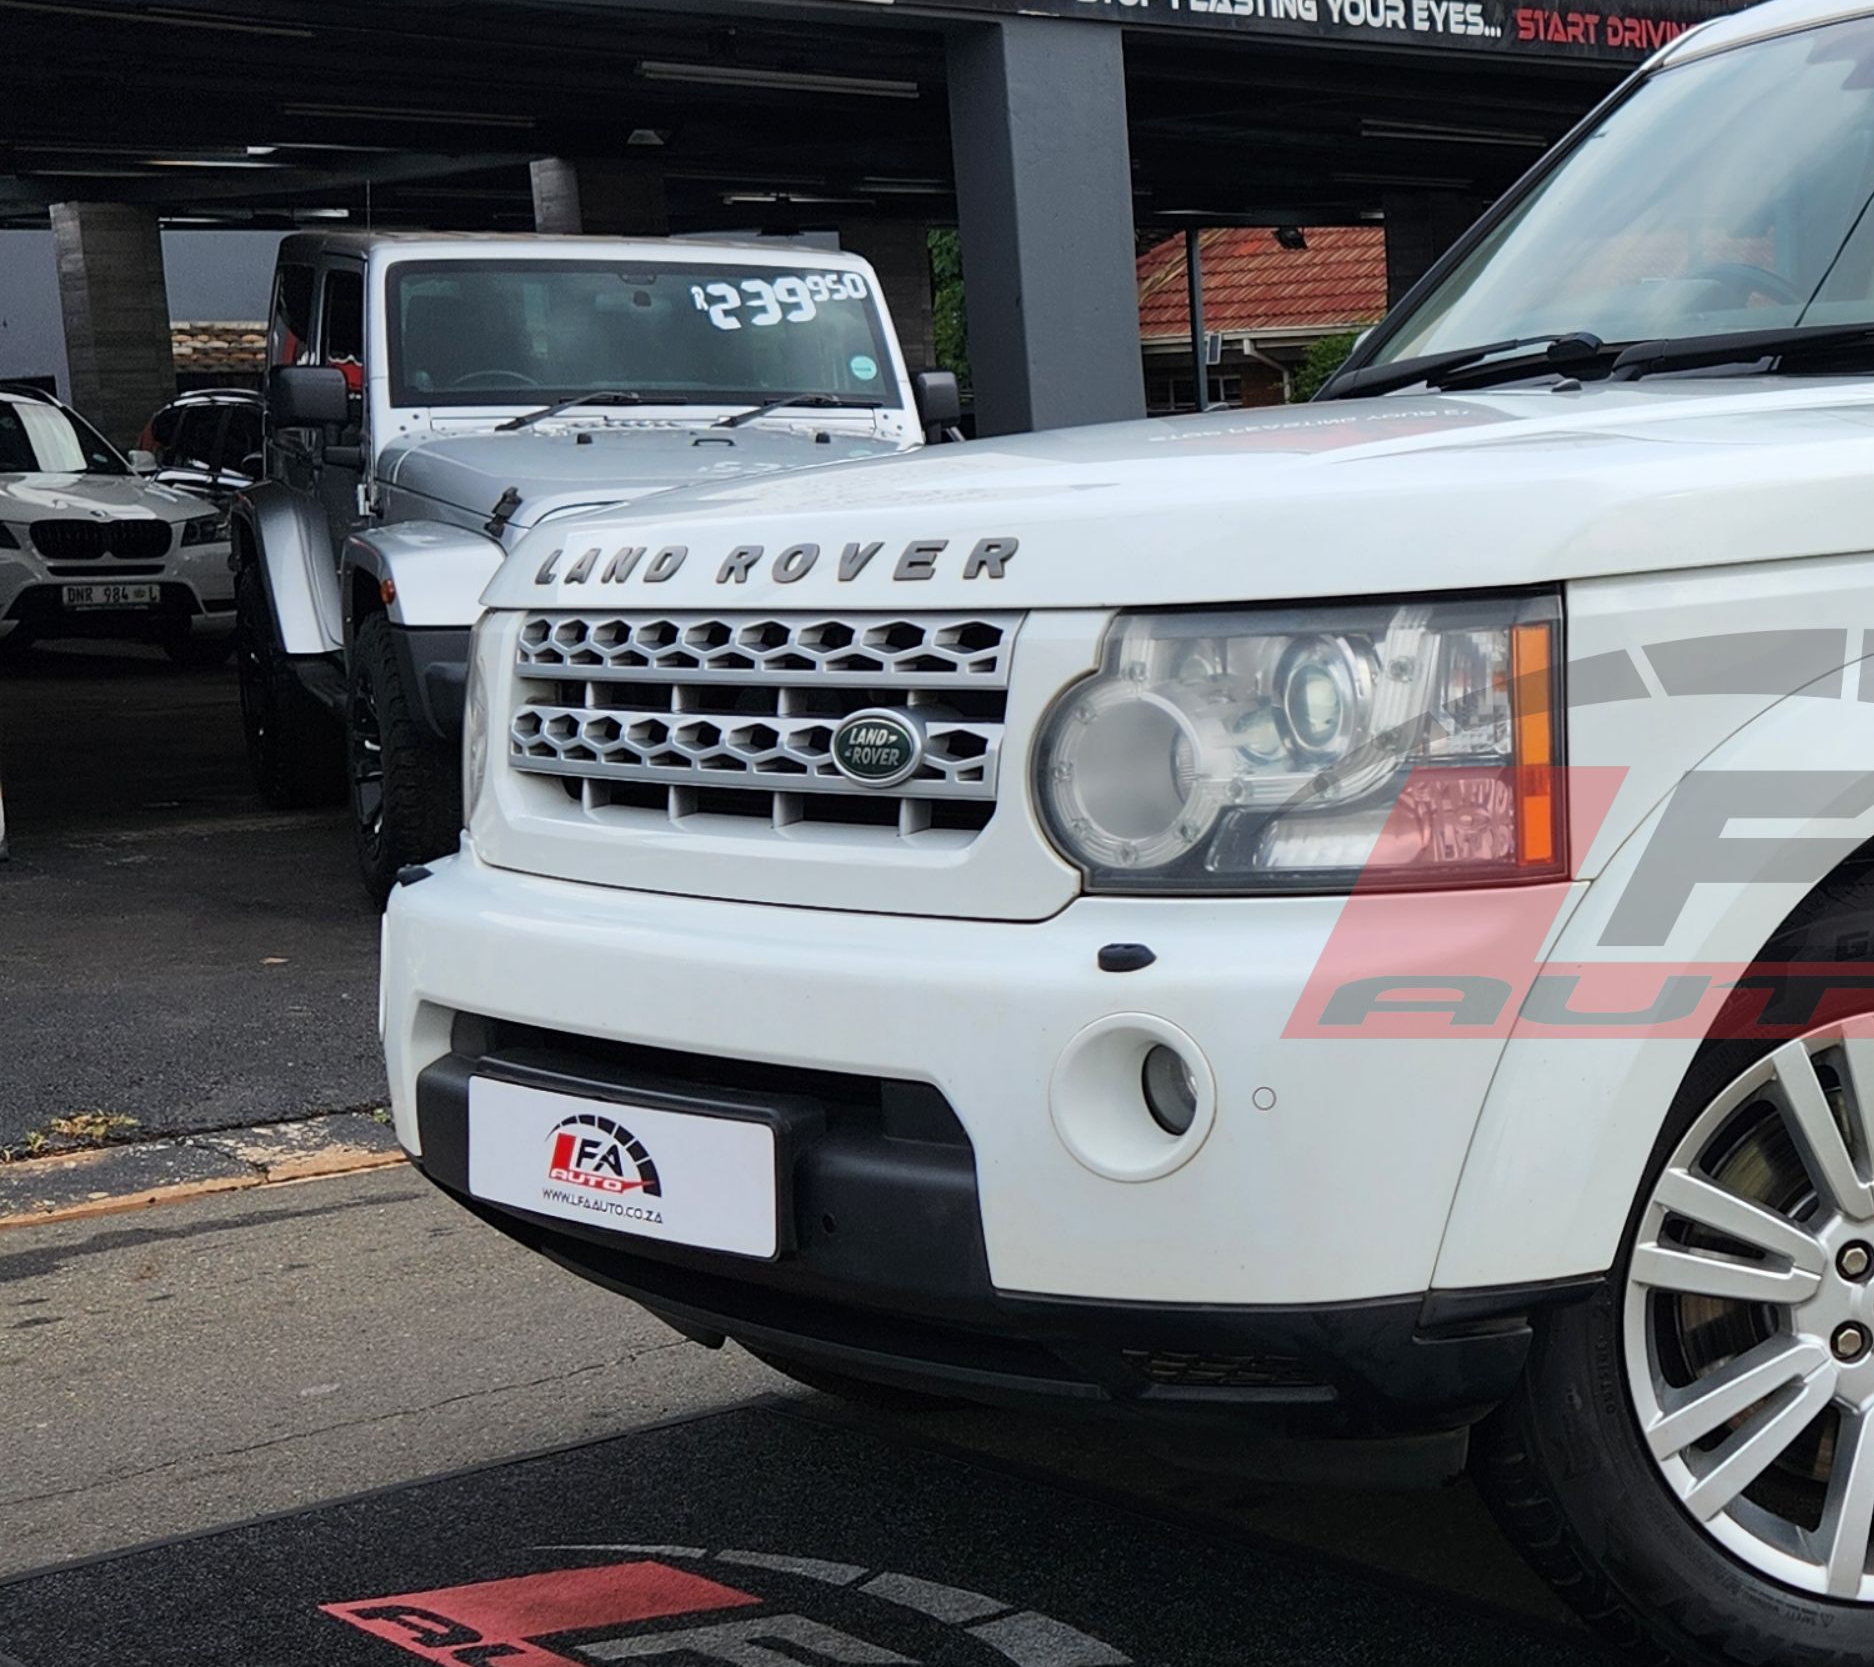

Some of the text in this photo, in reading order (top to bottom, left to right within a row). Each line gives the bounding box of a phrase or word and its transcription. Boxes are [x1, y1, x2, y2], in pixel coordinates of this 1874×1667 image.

[1516, 8, 1600, 45] START
[535, 537, 1019, 586] LAND ROVER
[104, 586, 128, 603] 984
[849, 728, 888, 746] LAND
[851, 747, 900, 766] ROVER
[551, 1168, 623, 1192] AUTO
[542, 1188, 664, 1224] WWW.LFAAUTO.CO.ZA
